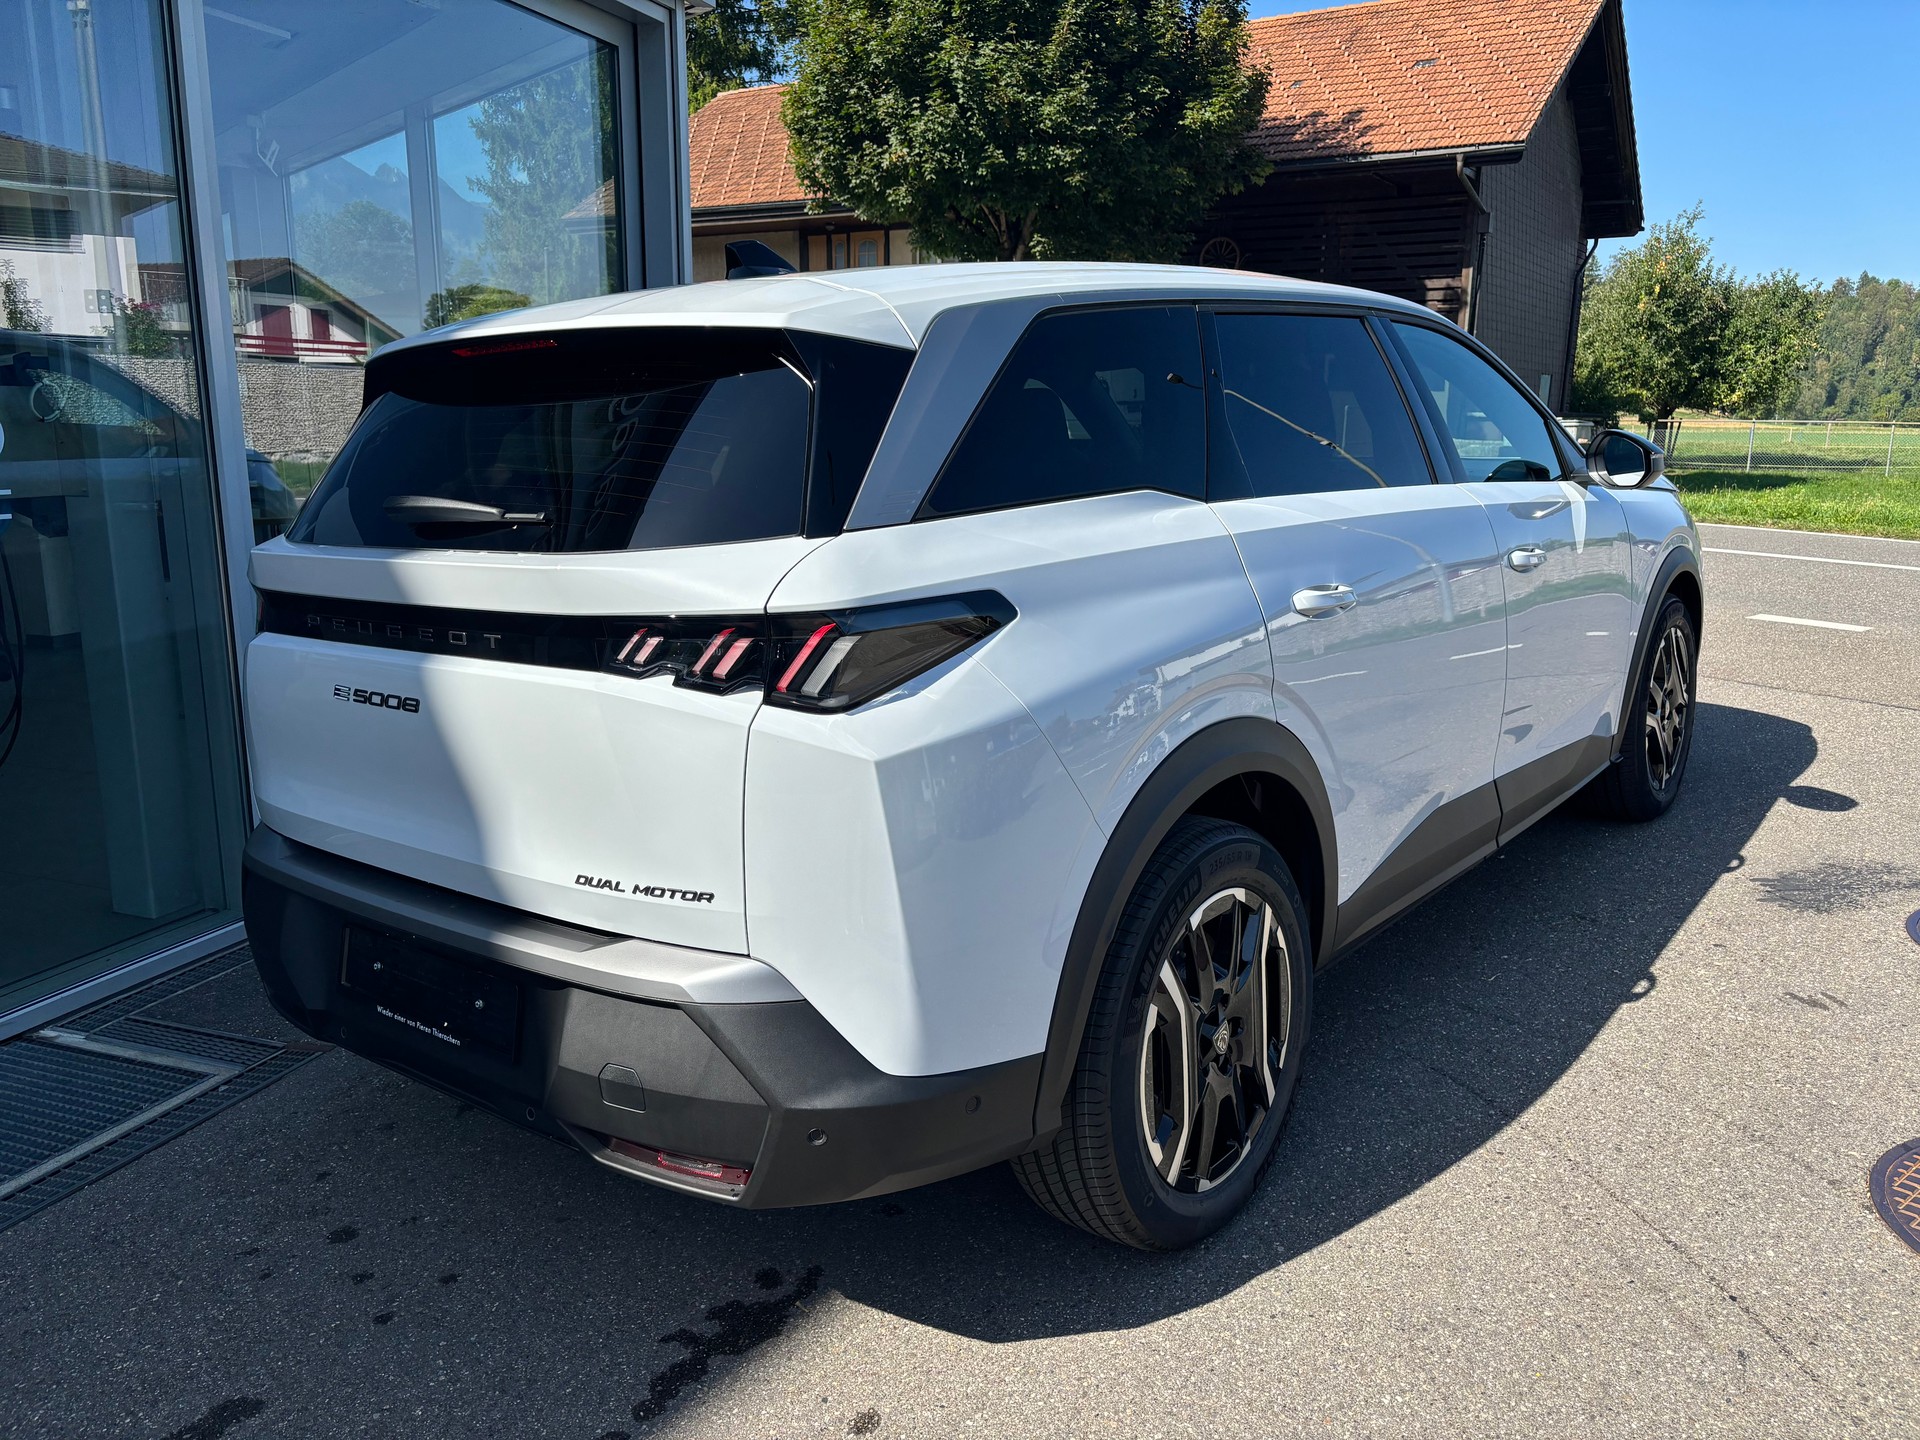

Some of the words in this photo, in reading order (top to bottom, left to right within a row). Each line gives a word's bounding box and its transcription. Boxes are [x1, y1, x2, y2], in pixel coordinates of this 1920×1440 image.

[307, 614, 501, 649] PEUGEOT
[575, 874, 625, 893] DUAL
[632, 884, 715, 904] MOTOR
[1140, 873, 1202, 990] MICHELIN
[377, 1004, 394, 1018] Wieder
[394, 1012, 407, 1024] einer
[407, 1019, 416, 1028] von
